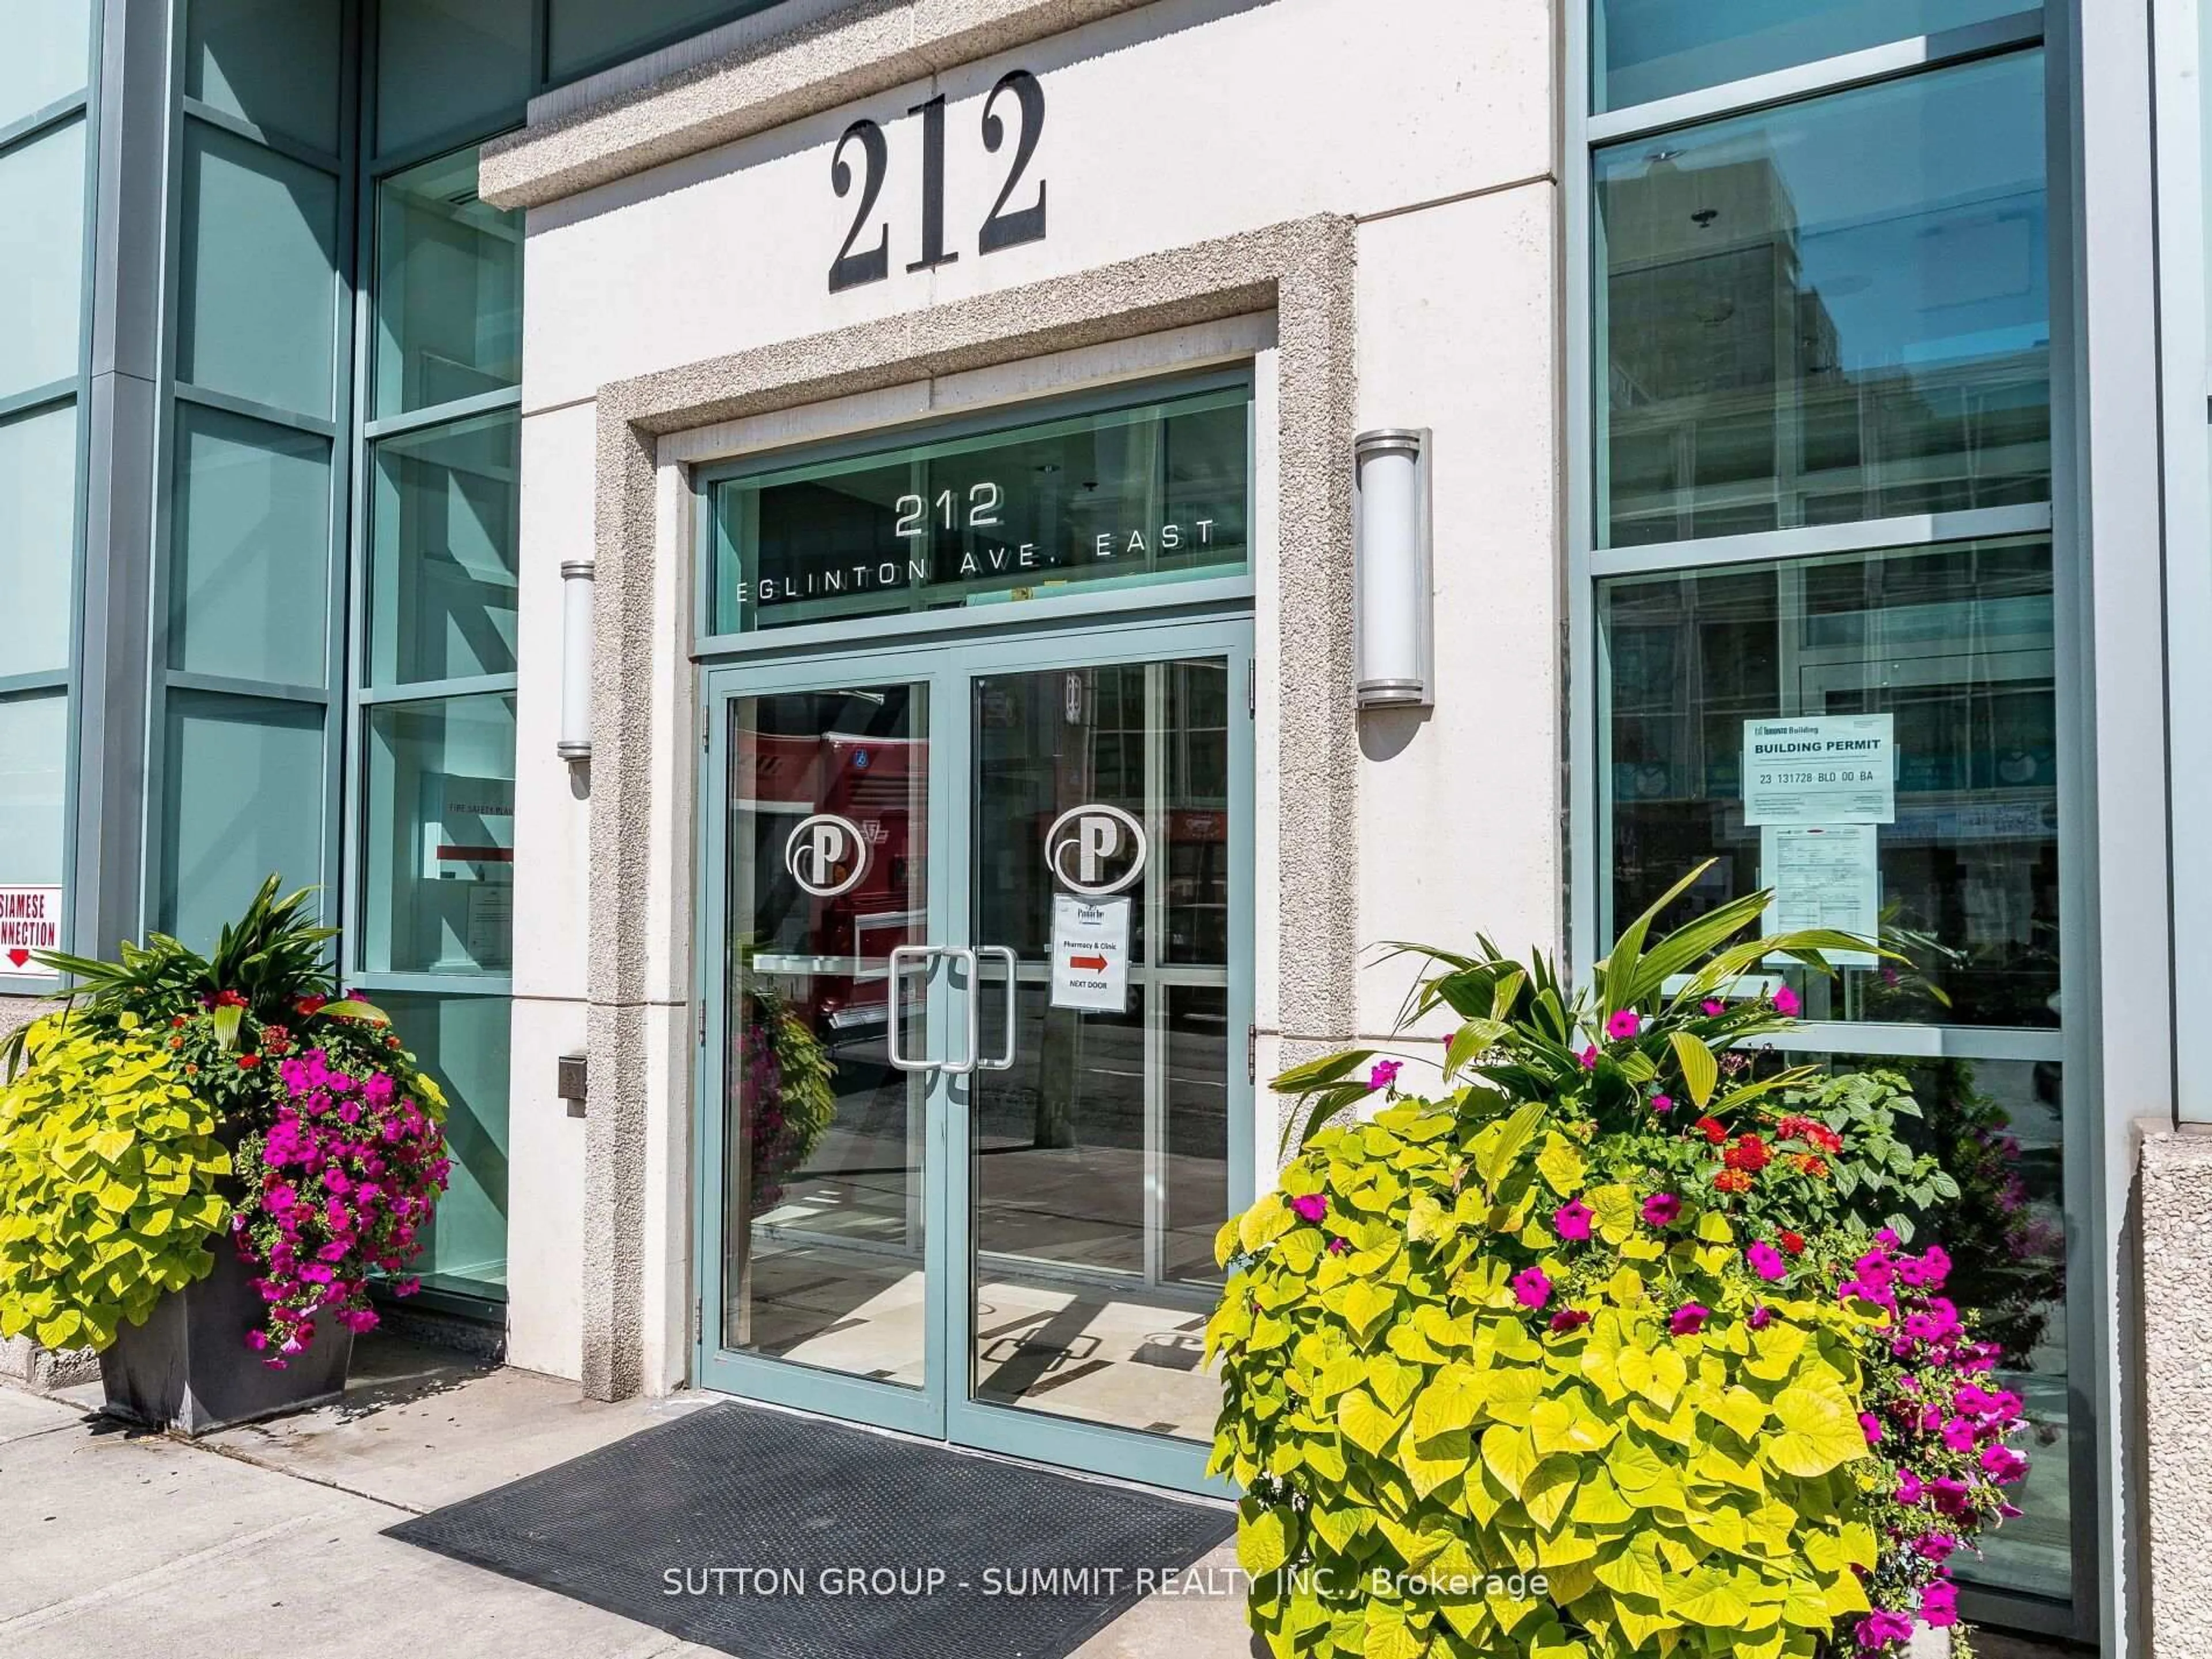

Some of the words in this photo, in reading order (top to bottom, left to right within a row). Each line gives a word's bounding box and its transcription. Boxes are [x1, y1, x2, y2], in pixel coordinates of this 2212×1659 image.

[829, 69, 1046, 294] 212
[895, 482, 998, 537] 212
[737, 559, 925, 603] EGLINTON
[960, 543, 1055, 574] AVE.
[1096, 519, 1214, 556] EAST
[1789, 726, 1819, 734] Building
[1755, 741, 1822, 754] BUILDING
[1826, 739, 1881, 751] PERMIT
[1760, 774, 1772, 784] 23
[1778, 773, 1812, 783] 131728
[1818, 772, 1836, 782] BLD
[1860, 771, 1873, 781] BA
[0, 894, 44, 918] SIAMESE
[1, 922, 55, 946] NNECTION
[1063, 940, 1093, 950] Pharmacy
[1070, 980, 1086, 988] NEXT
[1088, 981, 1107, 989] DOOR
